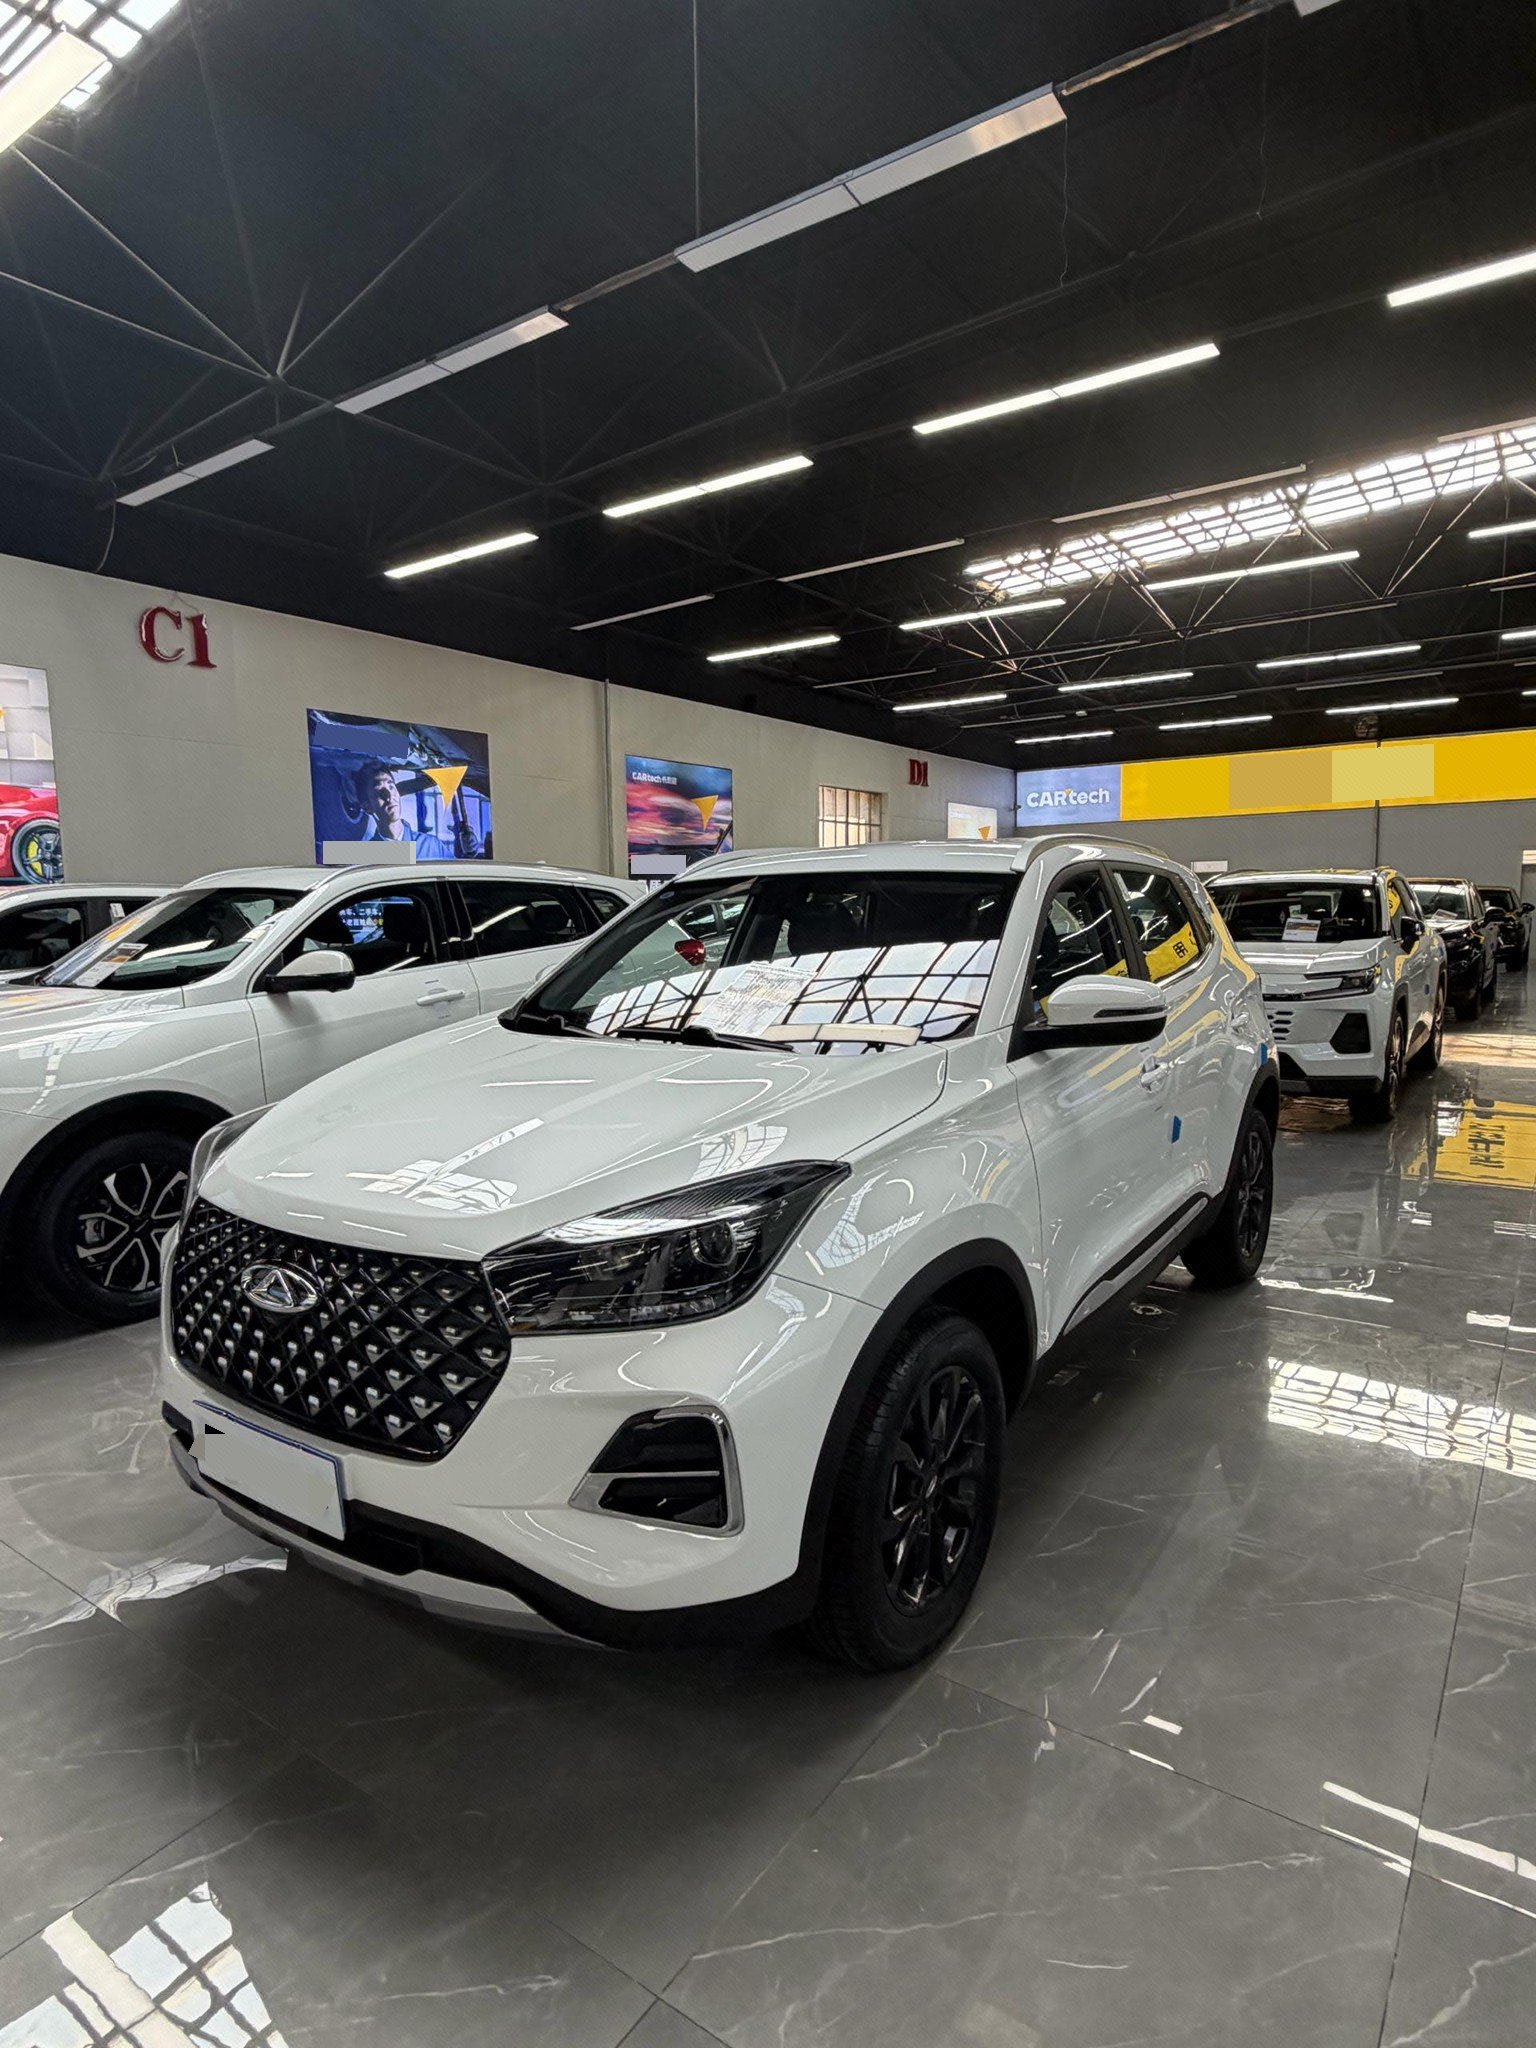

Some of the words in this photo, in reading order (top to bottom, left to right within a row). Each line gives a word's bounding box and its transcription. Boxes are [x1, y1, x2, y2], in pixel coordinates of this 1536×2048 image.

[139, 606, 217, 668] C1
[908, 758, 930, 788] D1
[1026, 787, 1110, 809] CARtech
